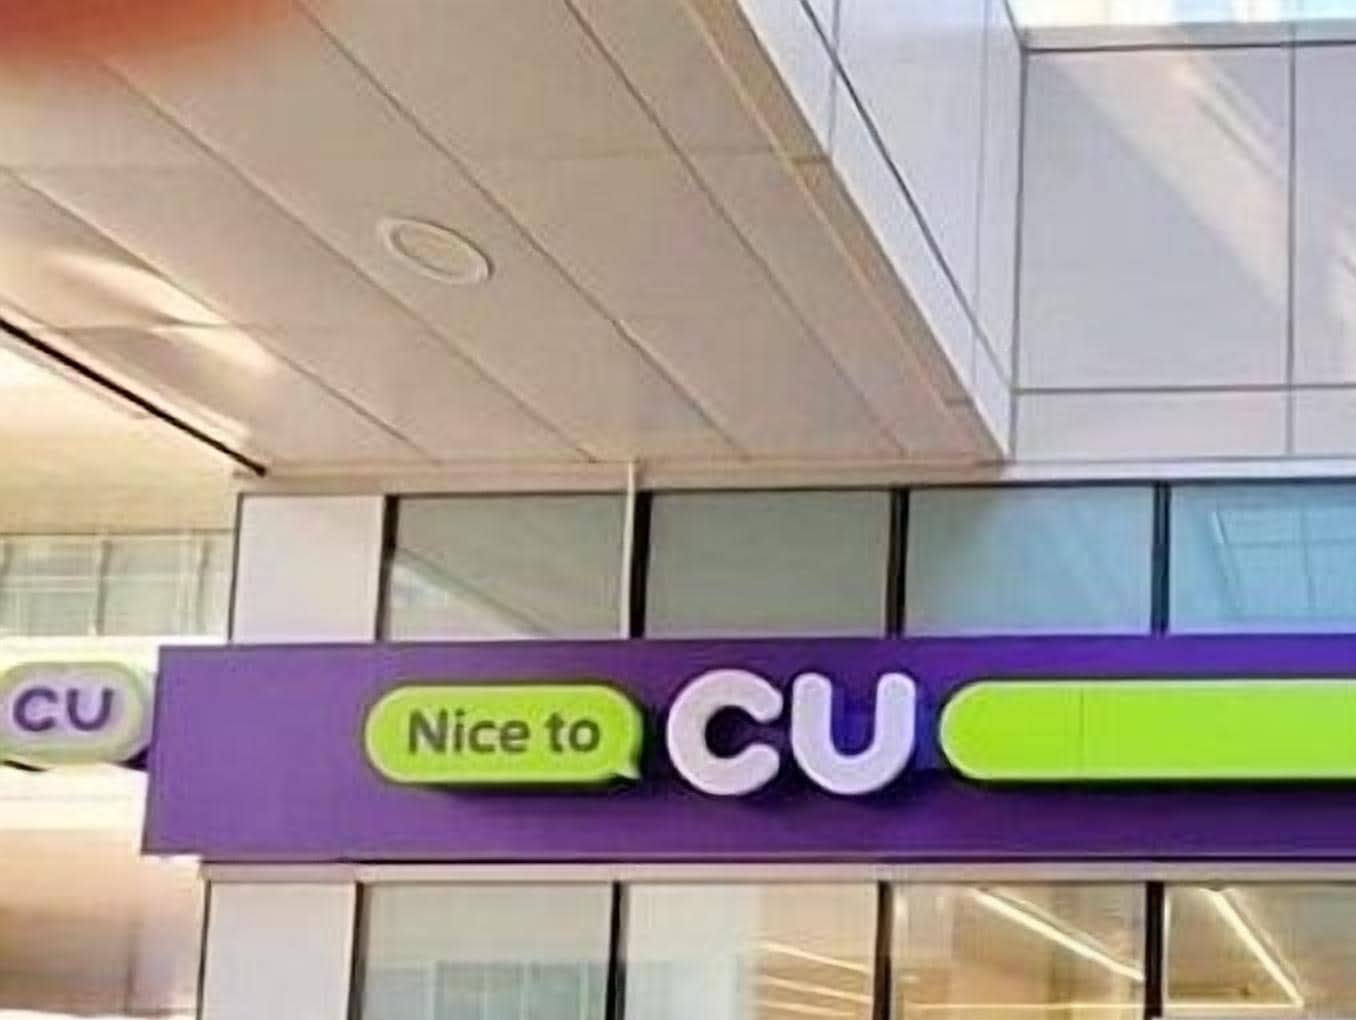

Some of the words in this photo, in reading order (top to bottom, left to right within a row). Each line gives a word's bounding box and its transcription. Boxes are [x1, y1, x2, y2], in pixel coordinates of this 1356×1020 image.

[13, 687, 115, 732] CU
[408, 710, 529, 754] Nice
[548, 714, 600, 753] to
[666, 668, 918, 796] CU
